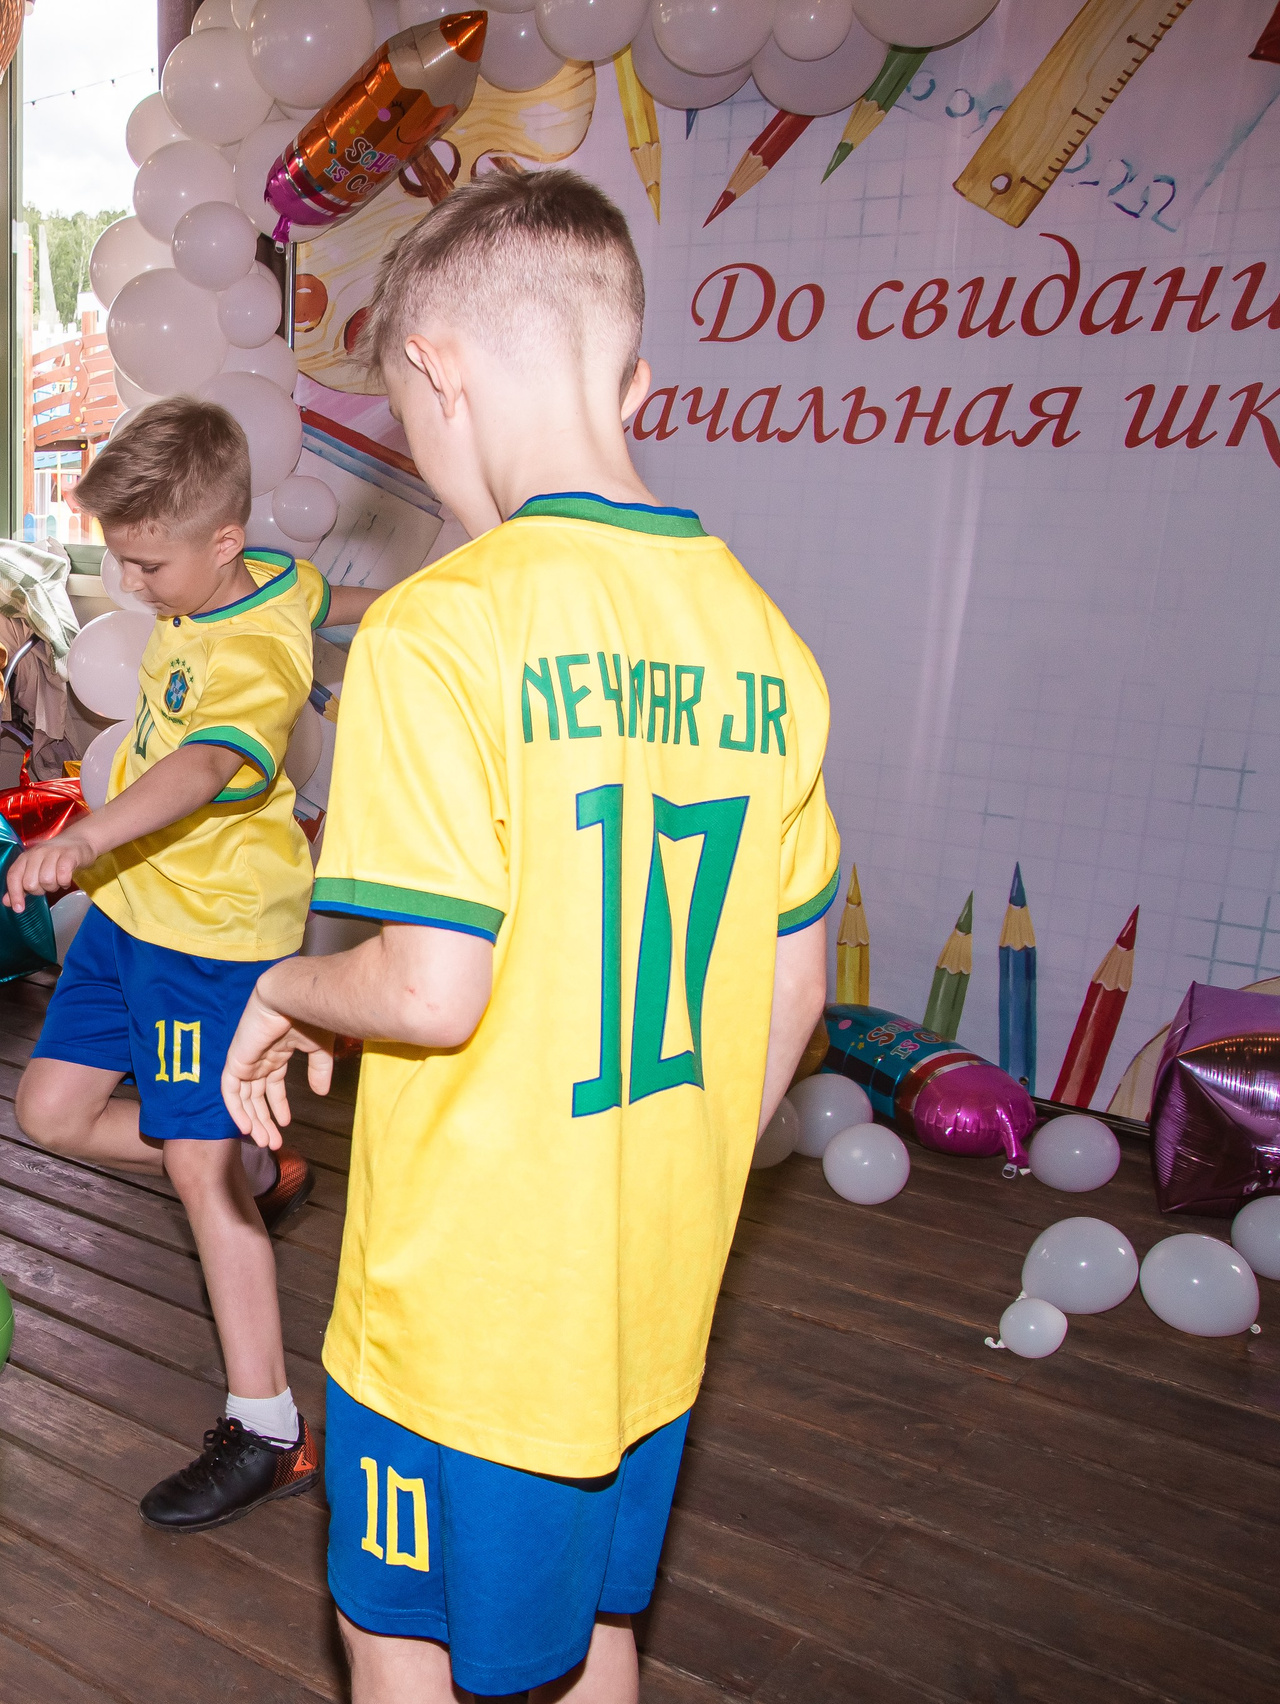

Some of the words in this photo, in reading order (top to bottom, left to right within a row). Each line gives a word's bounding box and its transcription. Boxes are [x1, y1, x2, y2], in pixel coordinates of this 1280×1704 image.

[691, 262, 826, 343] До
[624, 383, 1082, 449] ачальная
[522, 652, 705, 746] NEYMAR
[718, 671, 787, 756] JR
[155, 1020, 201, 1083] 10
[360, 1457, 430, 1572] 10
